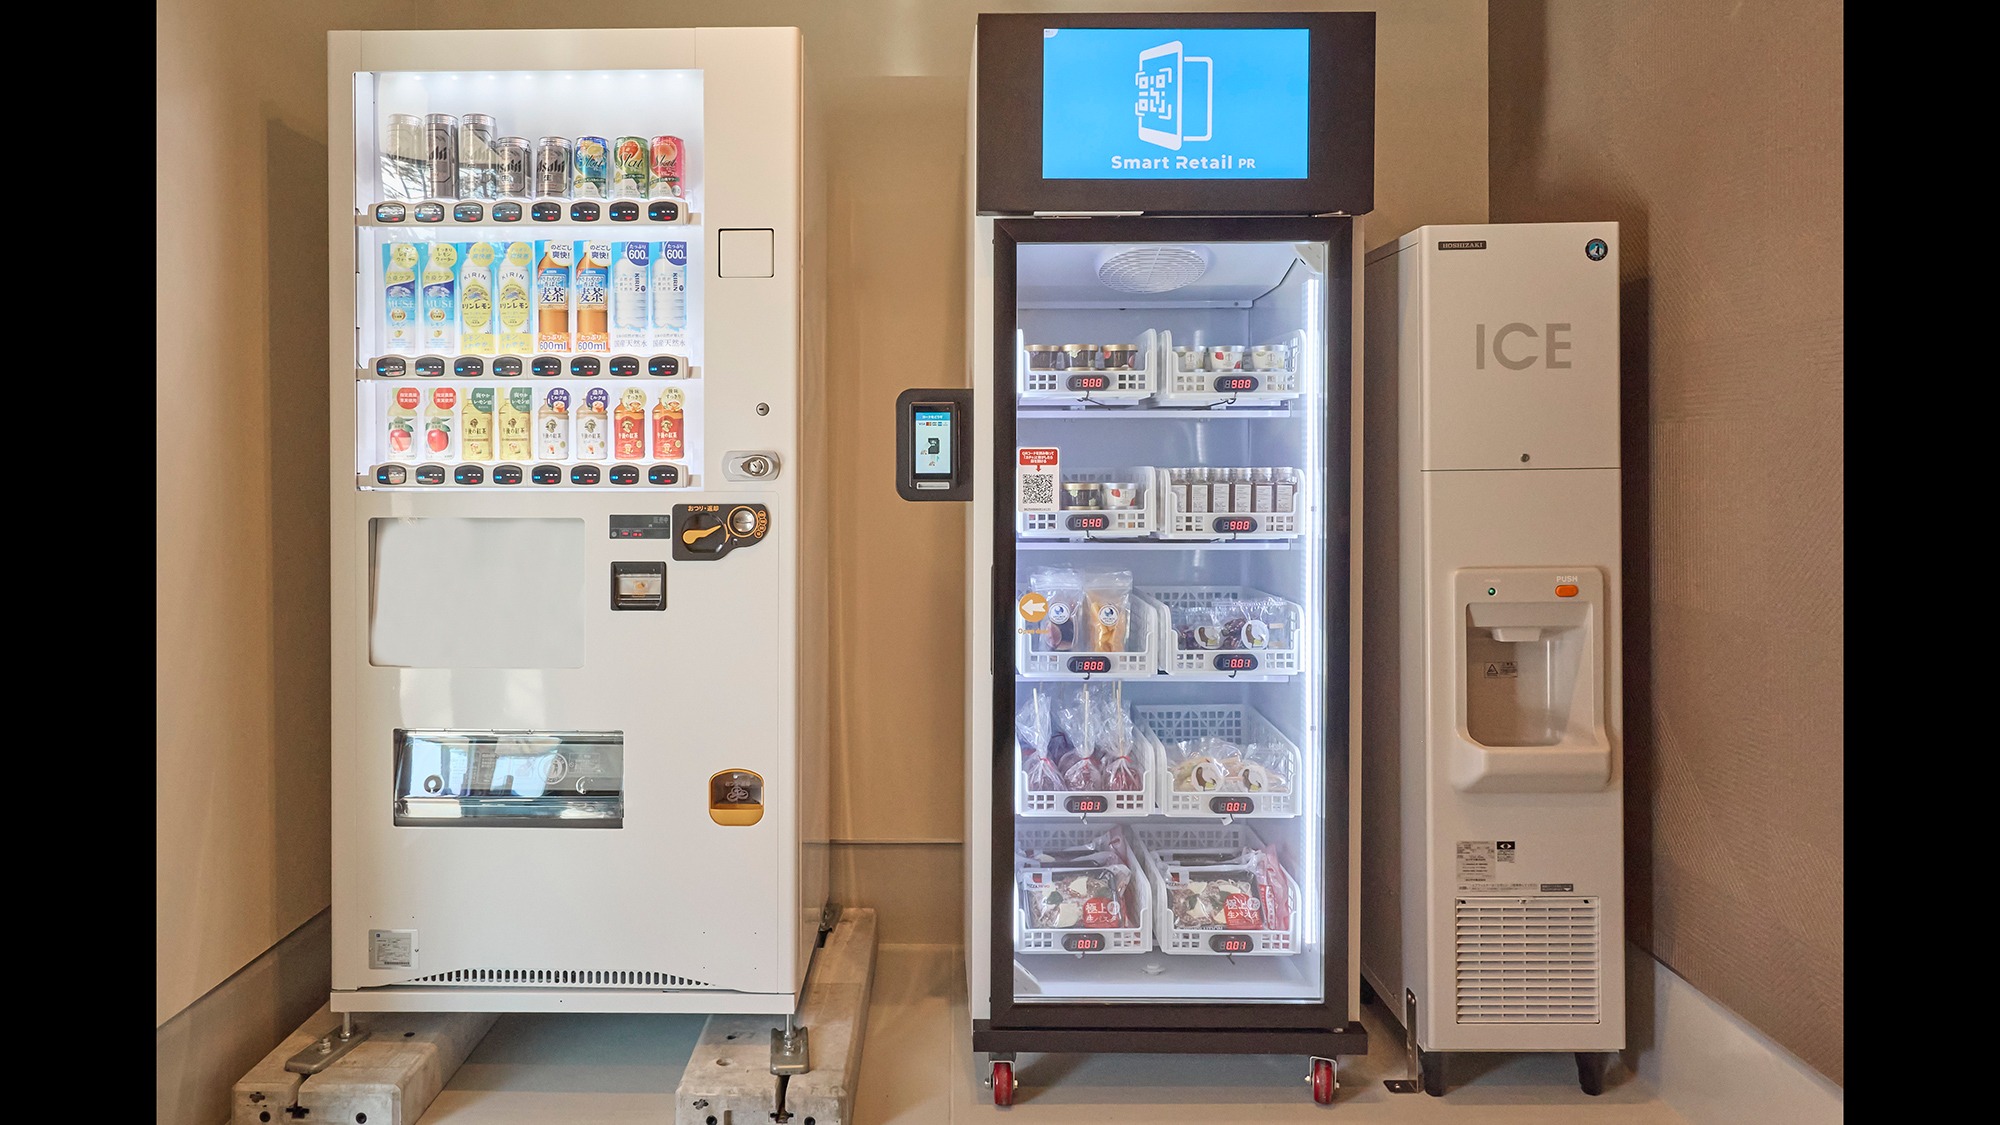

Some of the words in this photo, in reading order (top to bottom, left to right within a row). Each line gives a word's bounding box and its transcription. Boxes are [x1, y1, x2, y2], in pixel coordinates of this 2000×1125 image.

[1111, 155, 1169, 170] Smart
[1176, 155, 1233, 170] Retail
[1238, 158, 1256, 169] PR
[463, 271, 487, 281] KIRIN
[501, 271, 525, 281] KIRIN
[541, 287, 564, 302] 麦茶
[580, 287, 603, 302] 麦茶
[540, 341, 567, 350] 600ml
[578, 341, 606, 350] 600ml
[1476, 322, 1572, 371] ICE
[1082, 379, 1103, 387] 900
[1231, 380, 1251, 389] 900
[1230, 521, 1250, 530] 900
[1083, 661, 1104, 671] 800
[1086, 902, 1107, 914] 極上
